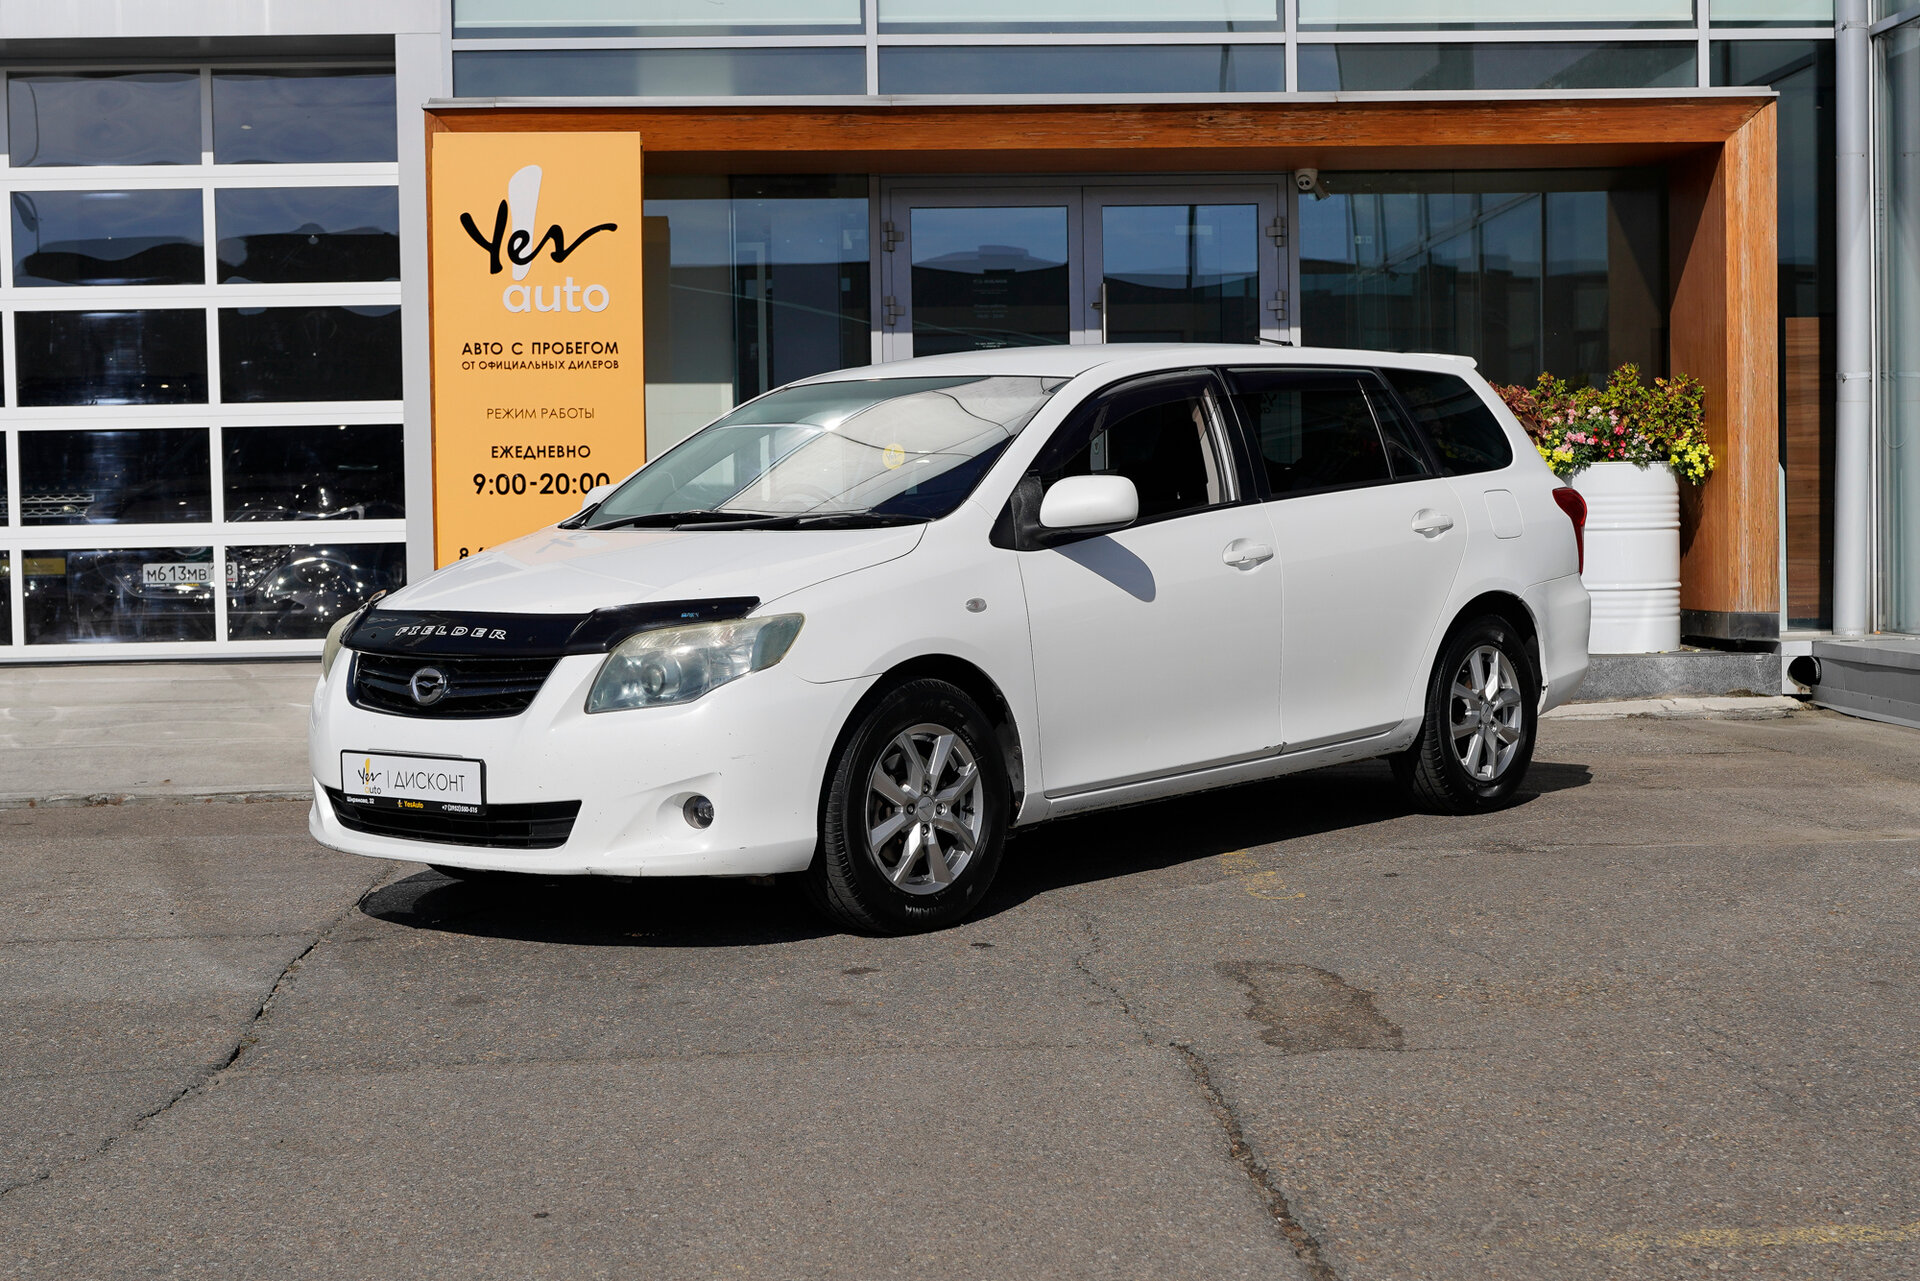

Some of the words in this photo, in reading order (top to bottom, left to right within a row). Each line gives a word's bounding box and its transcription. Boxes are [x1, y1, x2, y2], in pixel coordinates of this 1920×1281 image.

[459, 199, 618, 275] Yes
[503, 276, 611, 313] auto
[461, 341, 504, 356] АВТО
[511, 341, 524, 355] С
[531, 341, 619, 355] ПРОБЕГОМ
[461, 360, 476, 371] ОТ
[478, 360, 566, 371] ОФИЦИАЛЬНЫХ
[567, 359, 620, 370] ДИЛЕРОВ
[486, 407, 537, 420] РЕЖИМ
[541, 407, 595, 419] РАБОТЫ
[490, 444, 592, 460] ЕЖЕДНЕВНО
[394, 626, 506, 639] FIELDER
[394, 771, 465, 792] ДИСКОНТ
